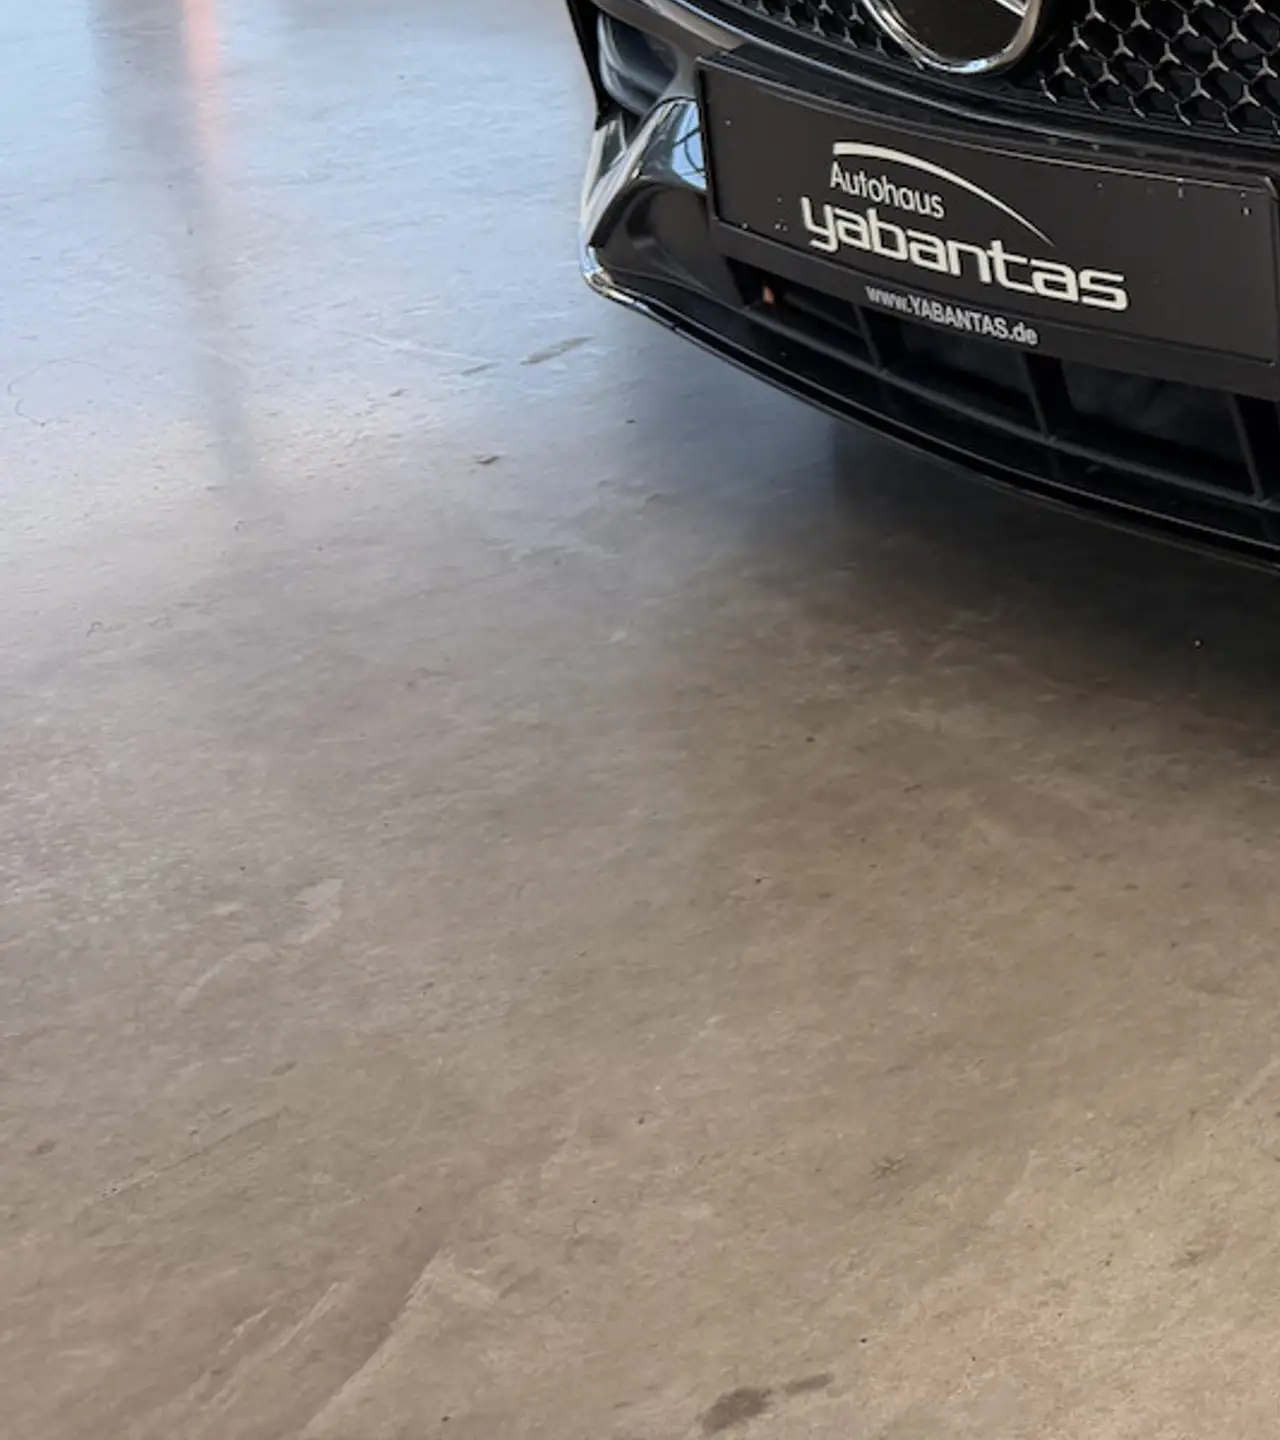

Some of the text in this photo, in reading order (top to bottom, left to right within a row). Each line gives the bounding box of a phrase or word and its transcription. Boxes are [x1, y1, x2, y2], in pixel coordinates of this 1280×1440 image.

[829, 161, 946, 219] Autohaus
[800, 196, 1130, 311] yabantas
[865, 283, 1039, 346] www.YABANTAS.de
